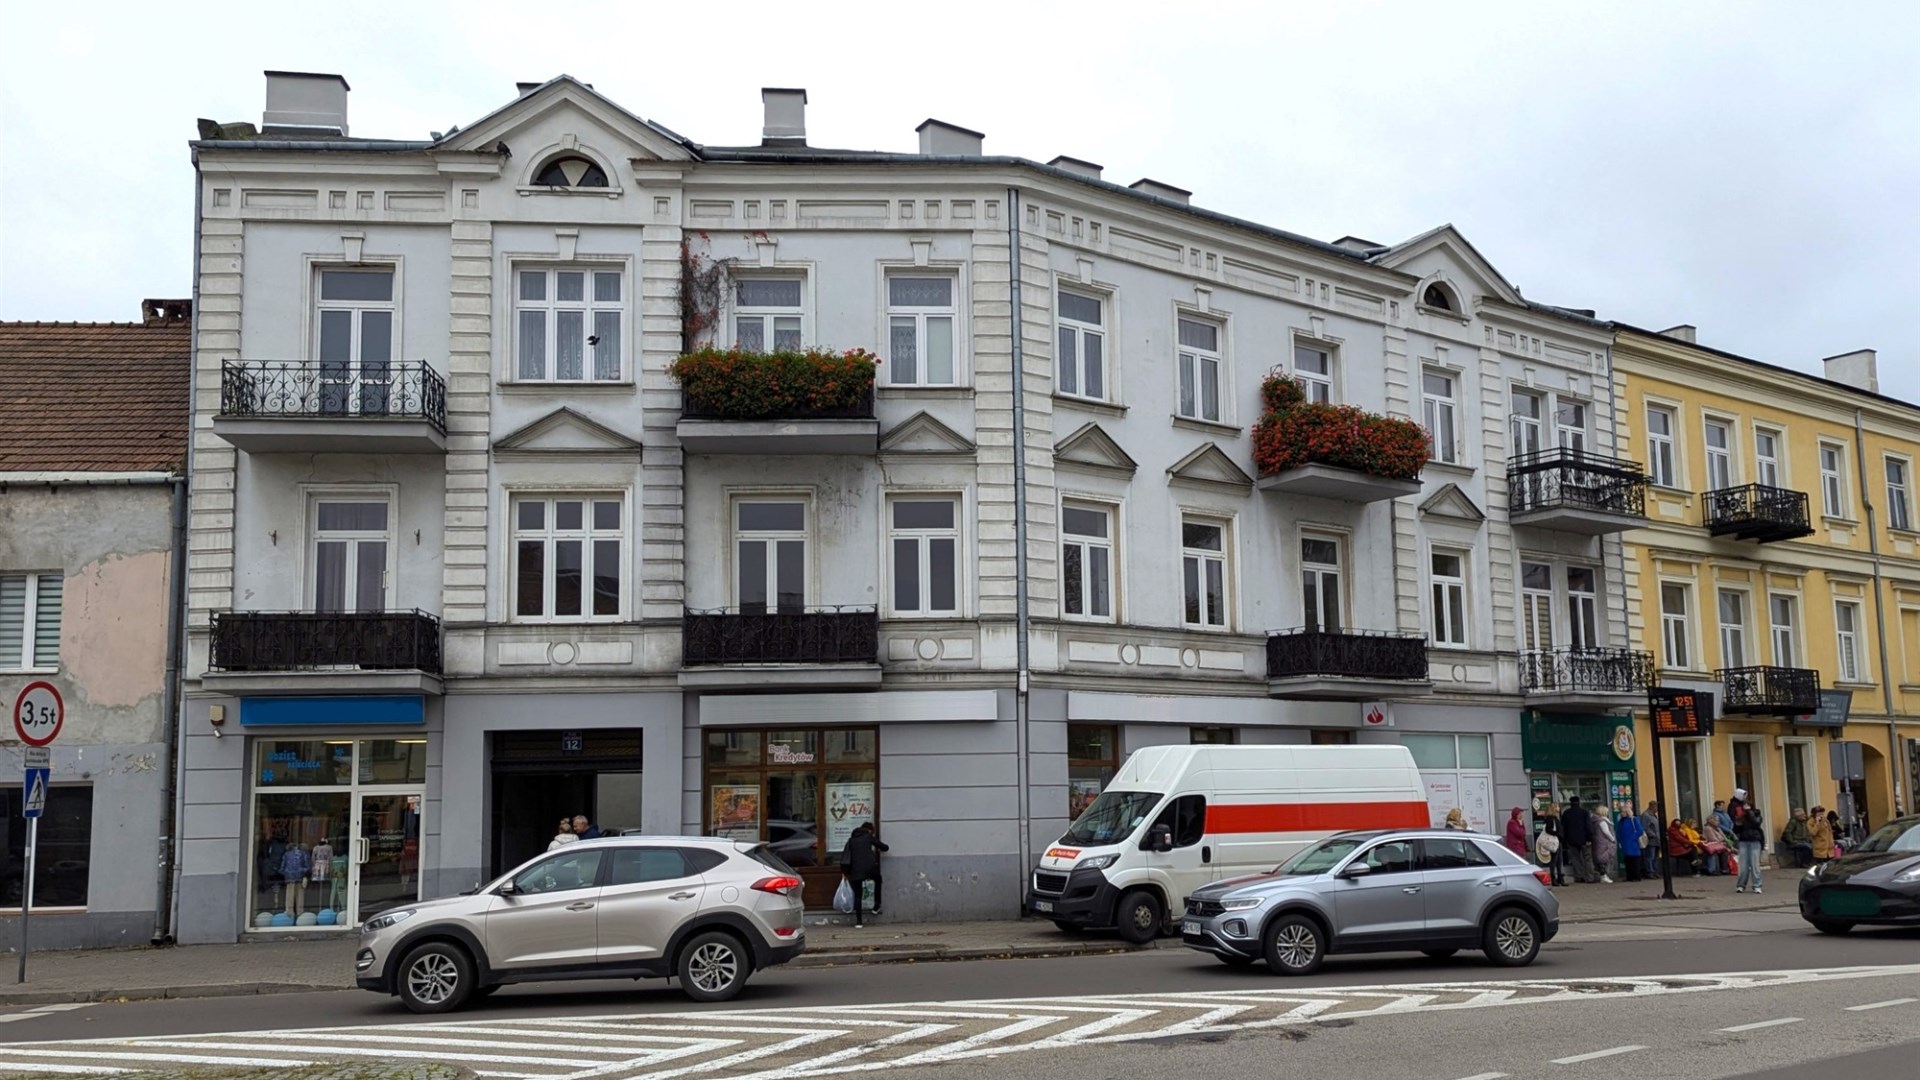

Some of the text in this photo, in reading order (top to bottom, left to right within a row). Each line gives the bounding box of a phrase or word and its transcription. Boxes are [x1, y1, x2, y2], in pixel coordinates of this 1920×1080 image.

[566, 740, 578, 750] 12
[769, 745, 789, 753] Bank
[775, 752, 813, 763] Kredytów
